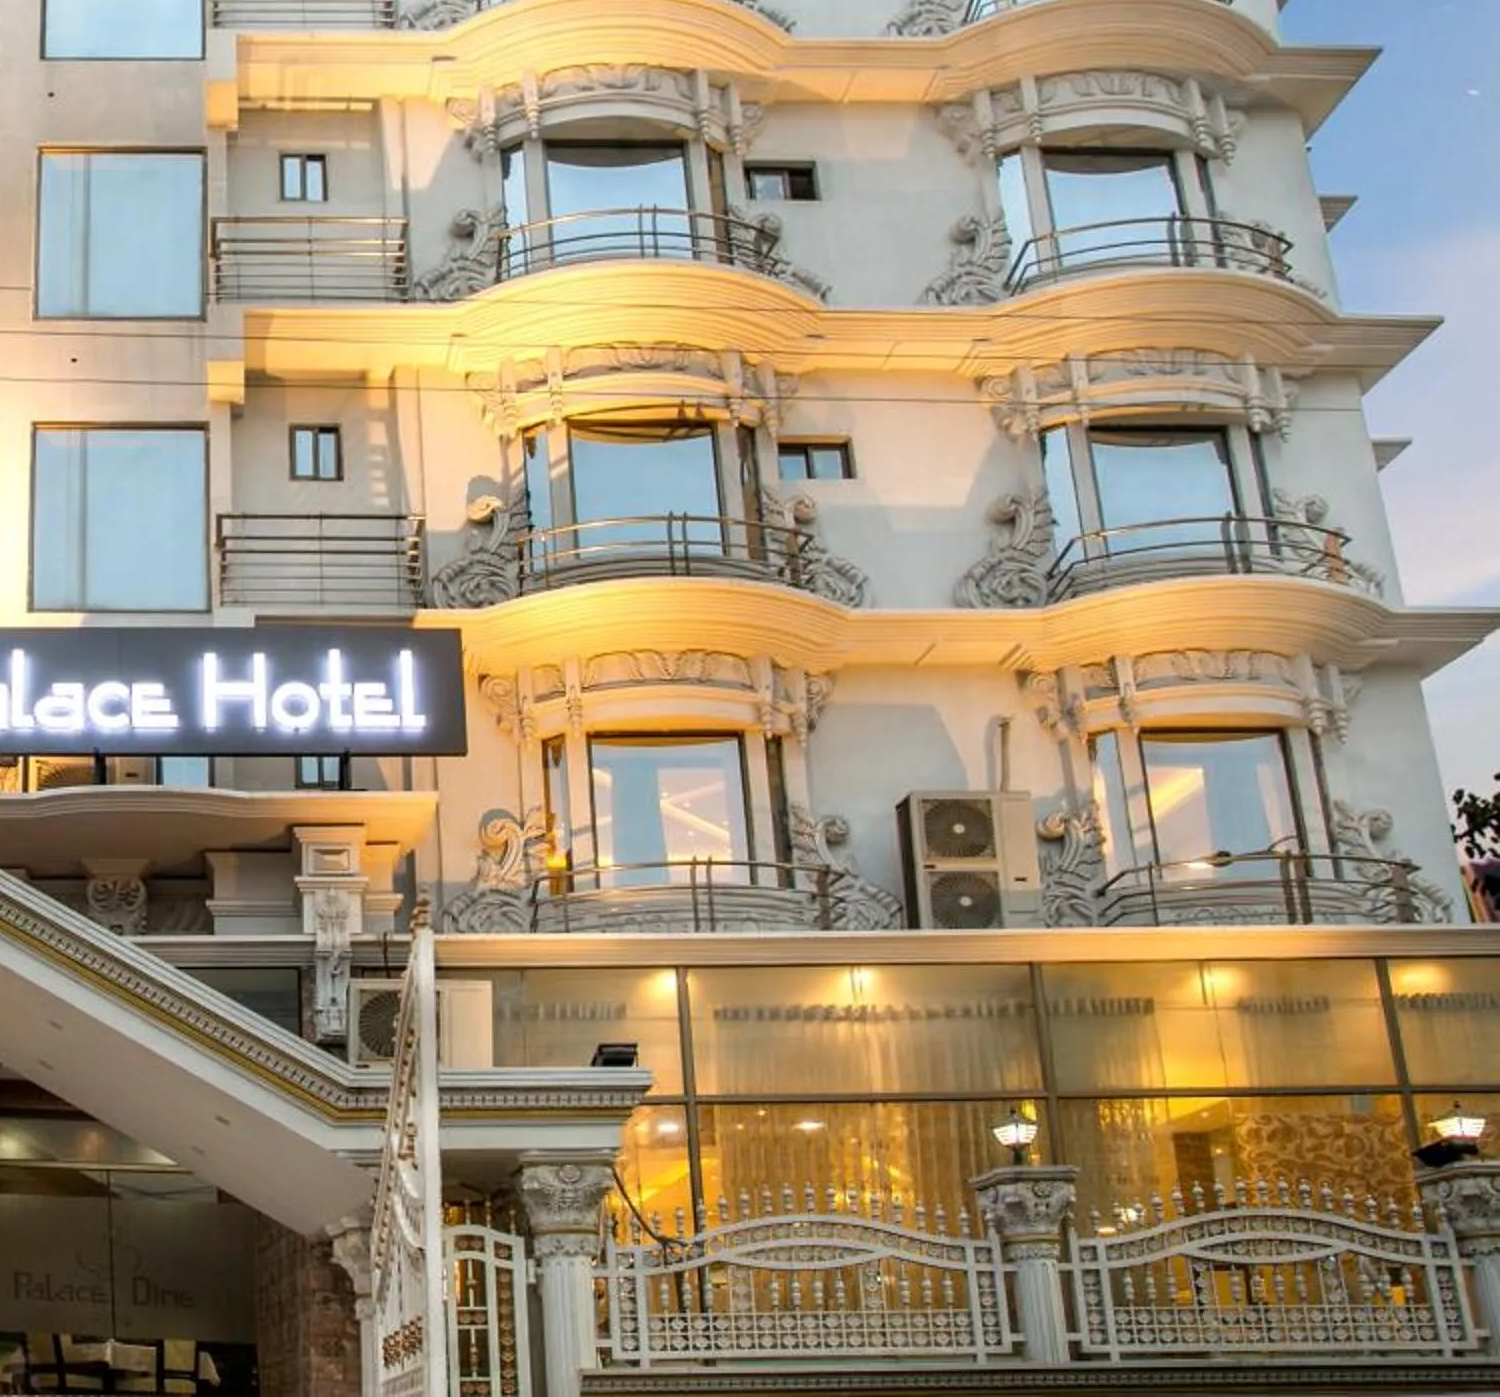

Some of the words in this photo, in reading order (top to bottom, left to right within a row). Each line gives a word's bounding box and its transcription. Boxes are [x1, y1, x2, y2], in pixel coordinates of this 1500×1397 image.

[203, 648, 426, 730] Hotel
[13, 1270, 111, 1305] Palace
[131, 1275, 196, 1308] Dine
